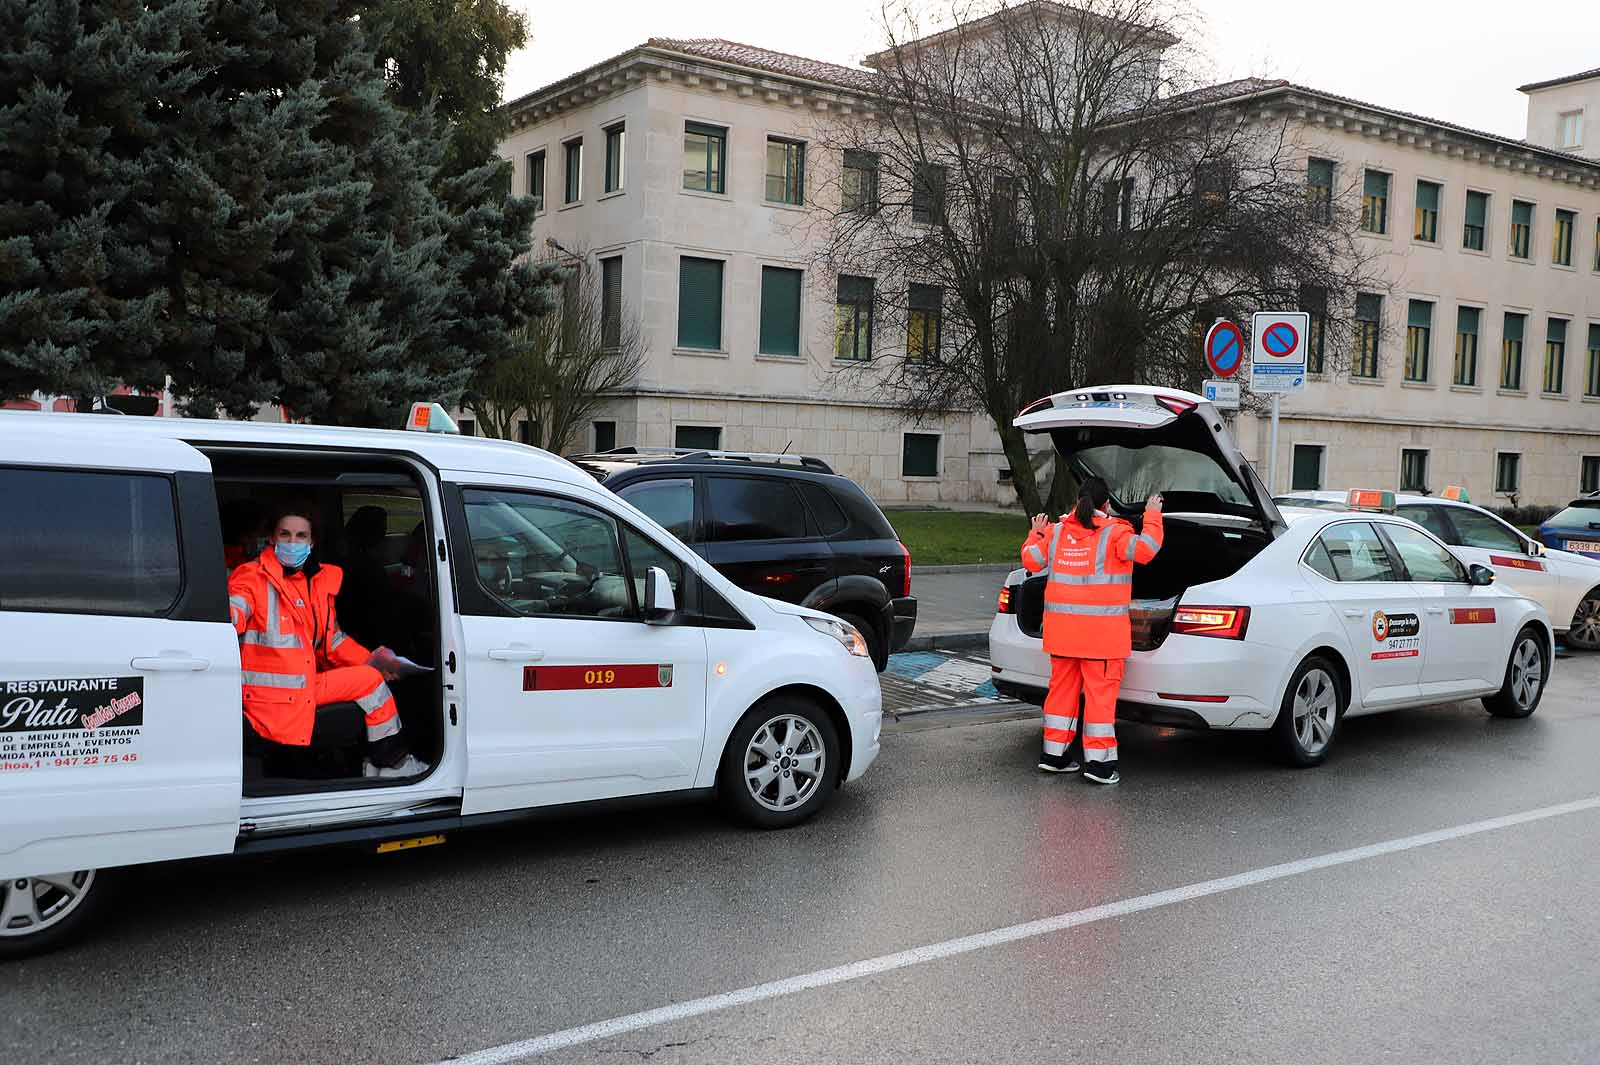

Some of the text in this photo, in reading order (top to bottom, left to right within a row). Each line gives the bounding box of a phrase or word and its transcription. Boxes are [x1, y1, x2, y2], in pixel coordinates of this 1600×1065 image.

[1388, 638, 1420, 649] 947 27 77 77
[584, 669, 615, 684] 019
[7, 679, 118, 694] RESTAURANTE
[0, 696, 79, 729] Plata
[27, 733, 59, 741] MENU
[62, 732, 79, 740] FIN
[99, 729, 140, 737] SEMANA
[3, 738, 131, 752] DE EMPRESA EVENTOS
[29, 750, 56, 759] PARA
[60, 748, 99, 756] LLEVAR
[55, 757, 78, 767] 947
[83, 756, 98, 765] 22
[103, 755, 118, 763] 75
[122, 753, 137, 762] 45
